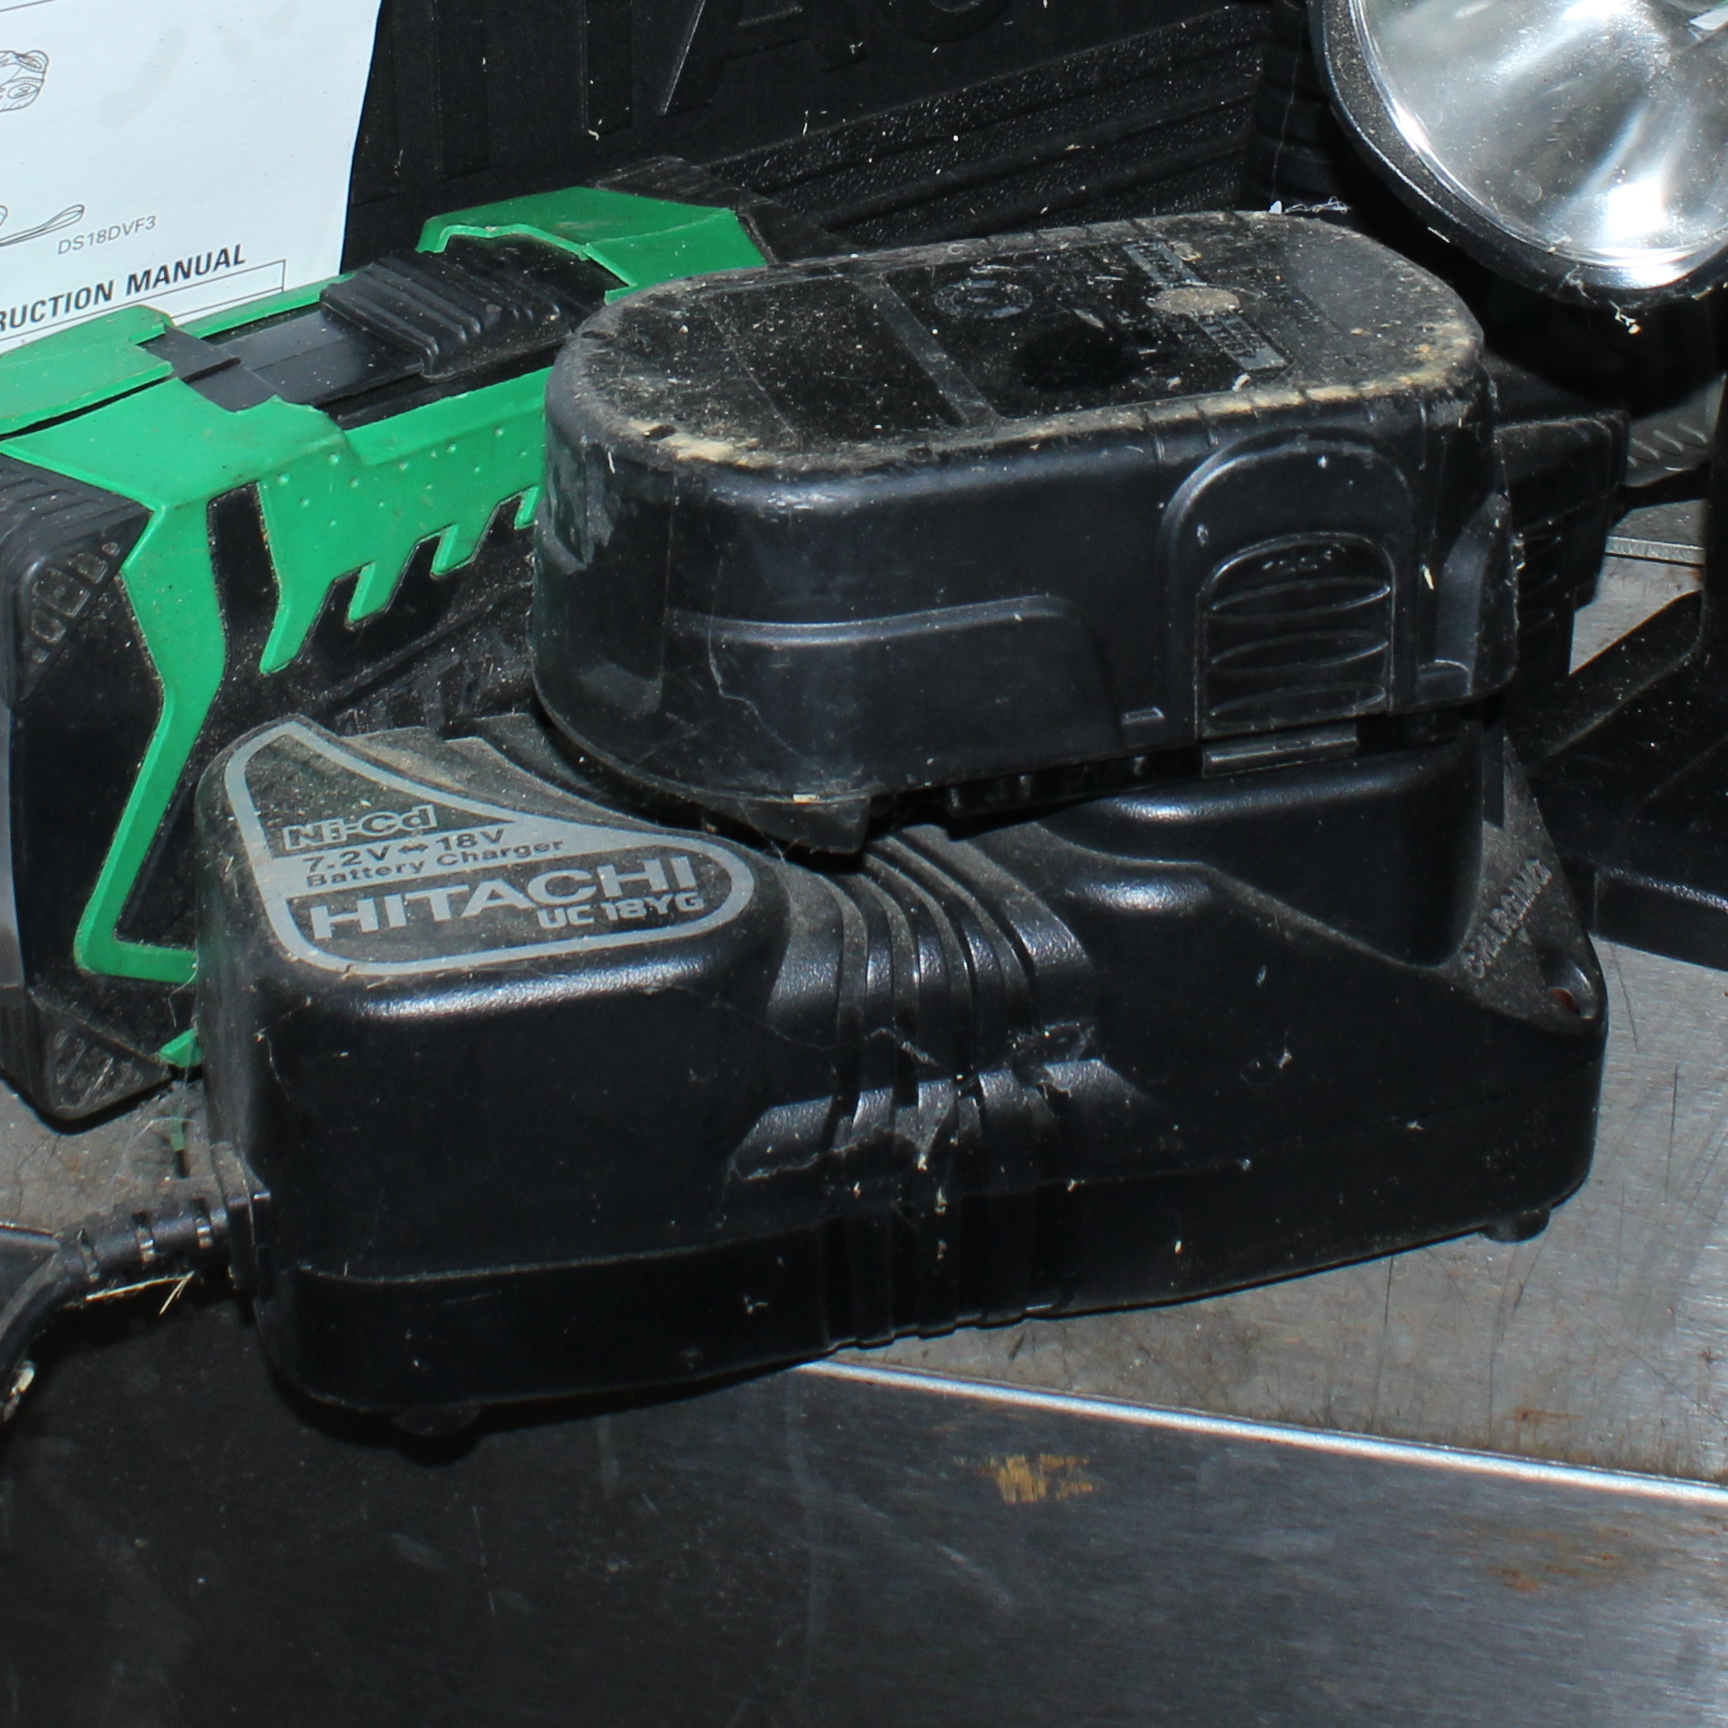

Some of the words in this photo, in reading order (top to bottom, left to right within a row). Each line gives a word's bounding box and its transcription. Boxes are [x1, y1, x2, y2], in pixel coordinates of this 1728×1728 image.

[57, 215, 158, 256] DS18DVF3
[126, 243, 248, 297] MANUAL
[281, 804, 438, 850] Ni-Cd
[302, 844, 390, 873] 7.2V
[435, 828, 508, 851] 18V
[306, 860, 425, 888] Battery
[436, 839, 564, 867] Charger
[309, 856, 698, 940] HITACHI
[536, 906, 597, 930] UC
[603, 890, 705, 921] 18YG
